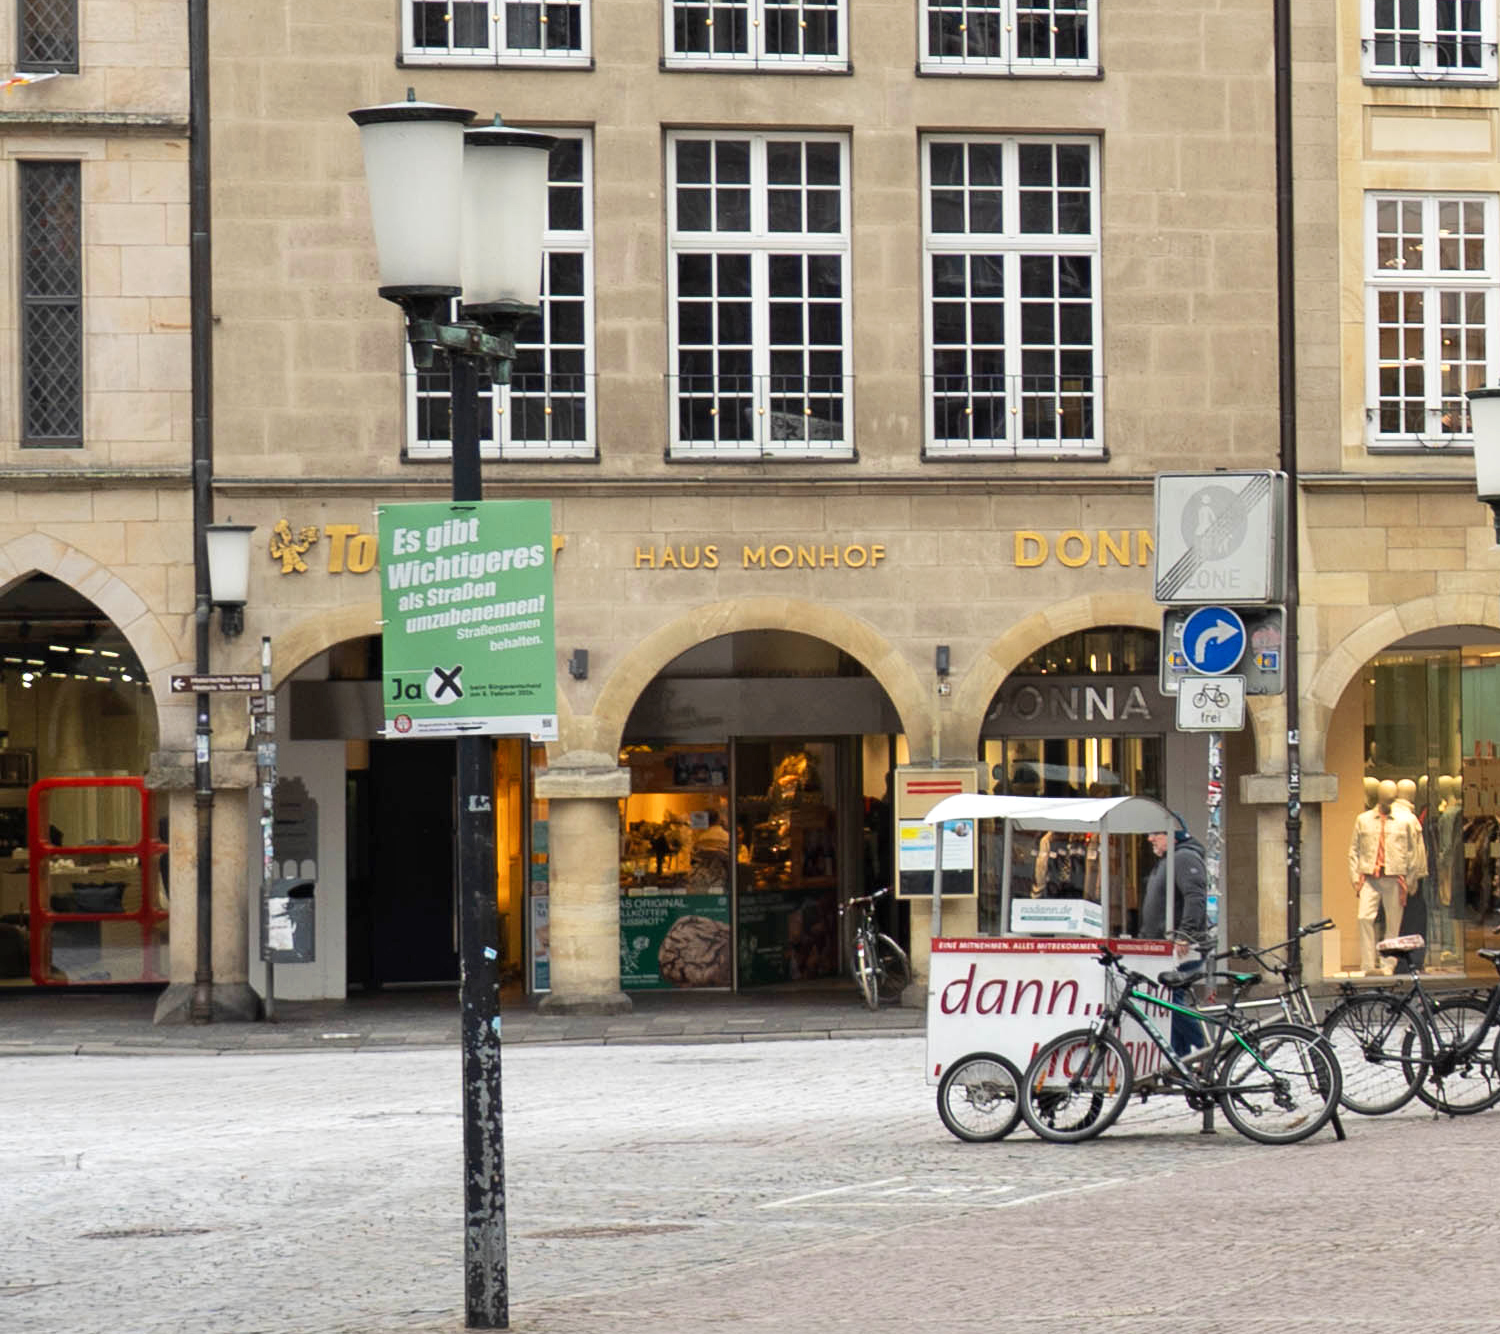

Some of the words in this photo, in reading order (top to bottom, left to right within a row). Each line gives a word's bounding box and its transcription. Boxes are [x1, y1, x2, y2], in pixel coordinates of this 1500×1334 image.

[393, 527, 421, 556] Es
[426, 517, 480, 553] gibt
[1014, 529, 1155, 568] DONN
[387, 544, 545, 591] Wichtigeres
[634, 544, 720, 569] HAUS
[742, 544, 887, 569] MONHOF
[1184, 568, 1242, 590] ZONE
[398, 592, 425, 612] als
[427, 580, 497, 607] Straßen
[405, 594, 546, 634] umzubenennen!
[456, 618, 541, 640] Straßennamen
[489, 634, 544, 652] behalten.
[391, 678, 422, 701] Ja
[1200, 711, 1222, 724] frei
